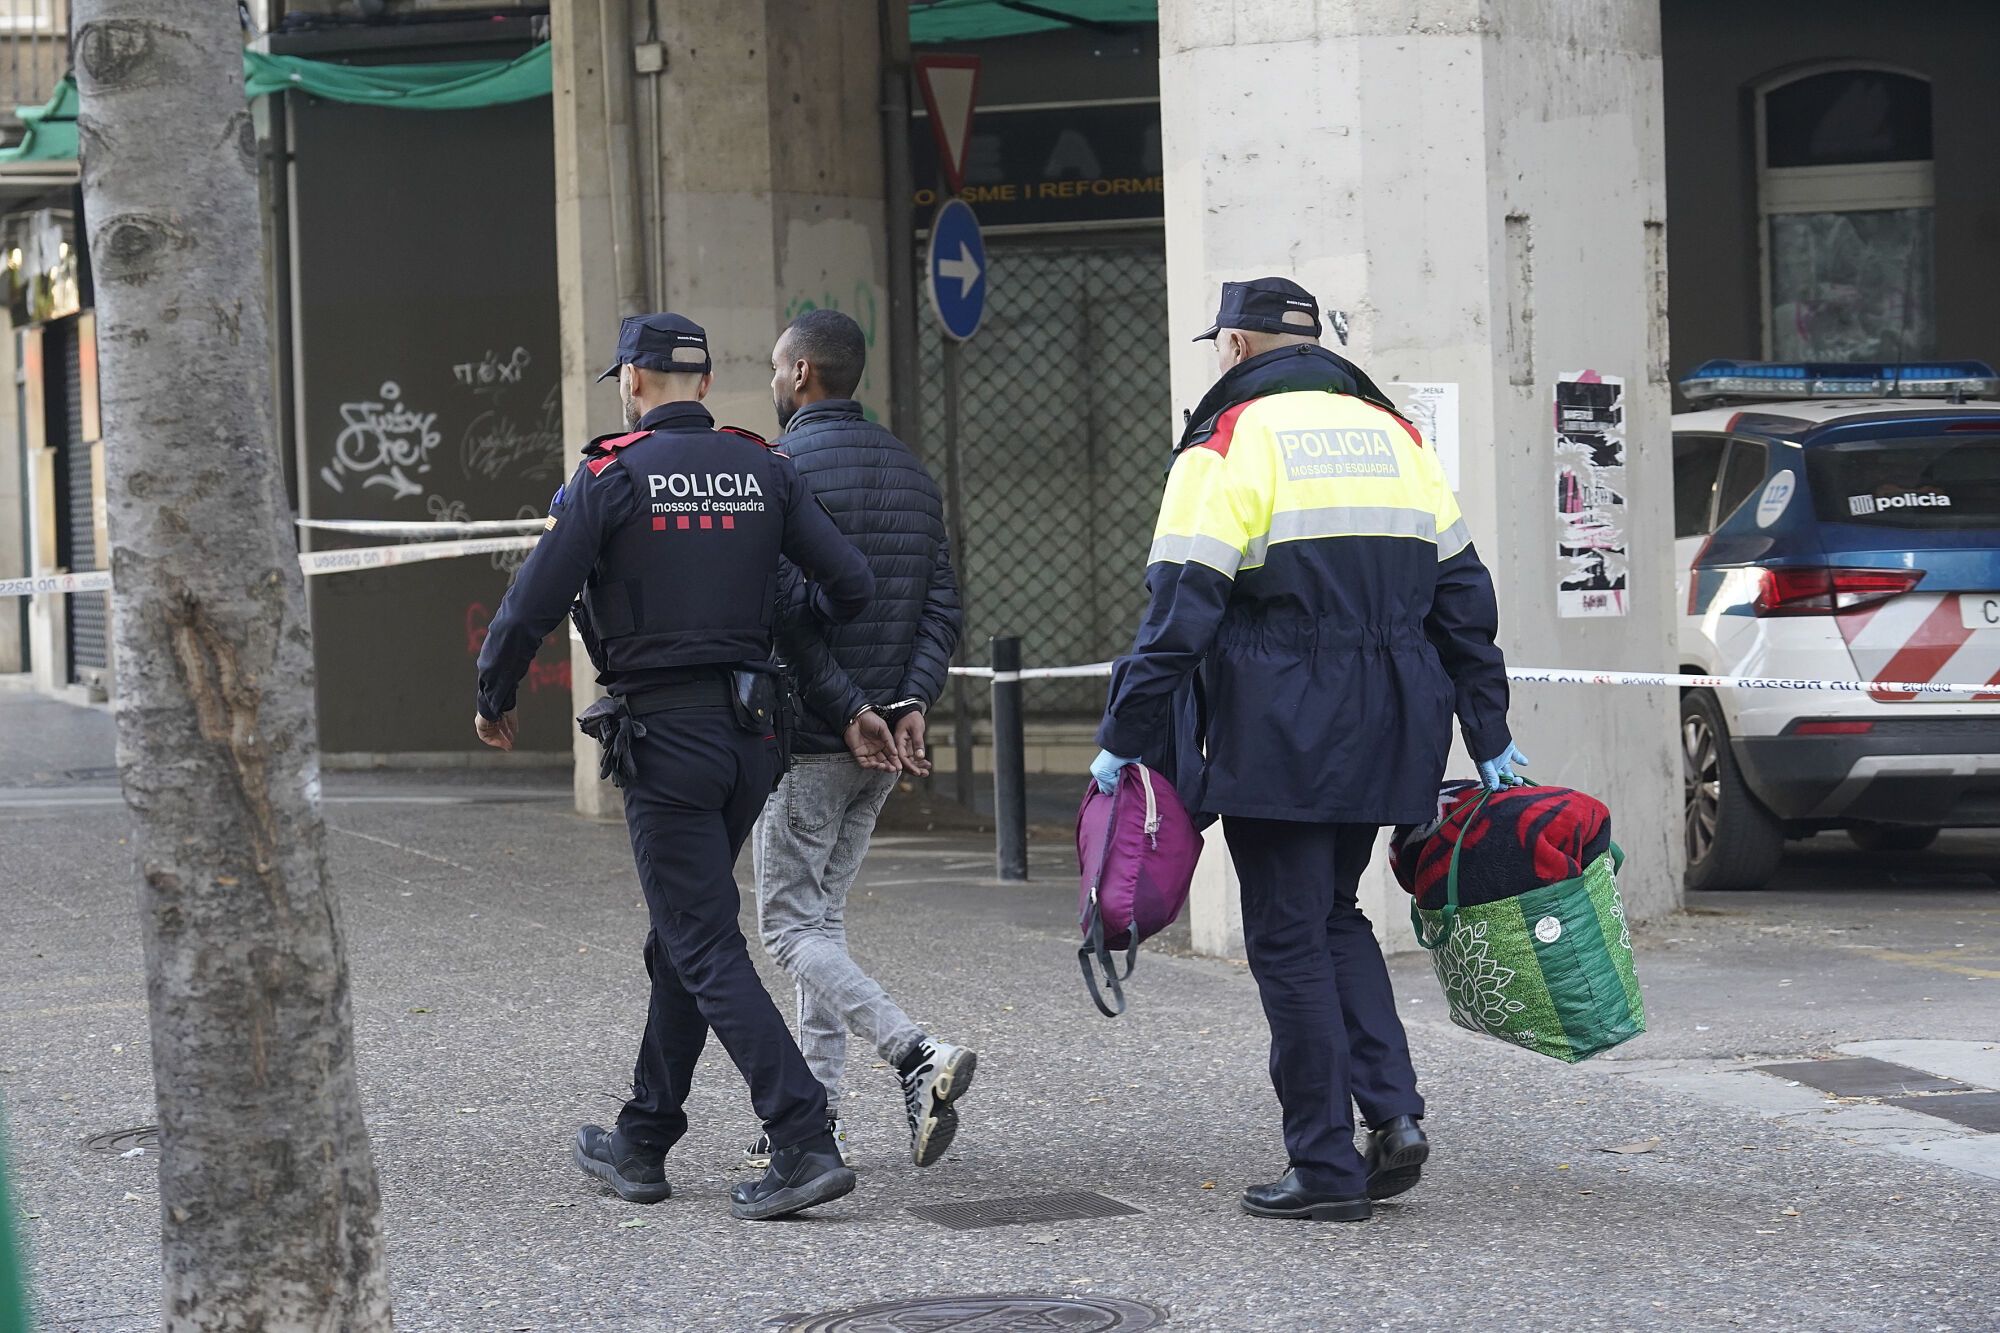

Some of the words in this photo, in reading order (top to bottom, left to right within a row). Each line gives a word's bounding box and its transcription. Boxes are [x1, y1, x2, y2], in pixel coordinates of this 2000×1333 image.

[1281, 431, 1392, 459] POLICIA
[1290, 463, 1334, 477] MOSSOS
[648, 472, 763, 498] POLICIA
[1765, 485, 1789, 504] 112
[652, 502, 699, 513] mossos
[701, 499, 765, 513] d'esquadra
[1875, 492, 1951, 511] policia
[1514, 1029, 1535, 1040] 70%
